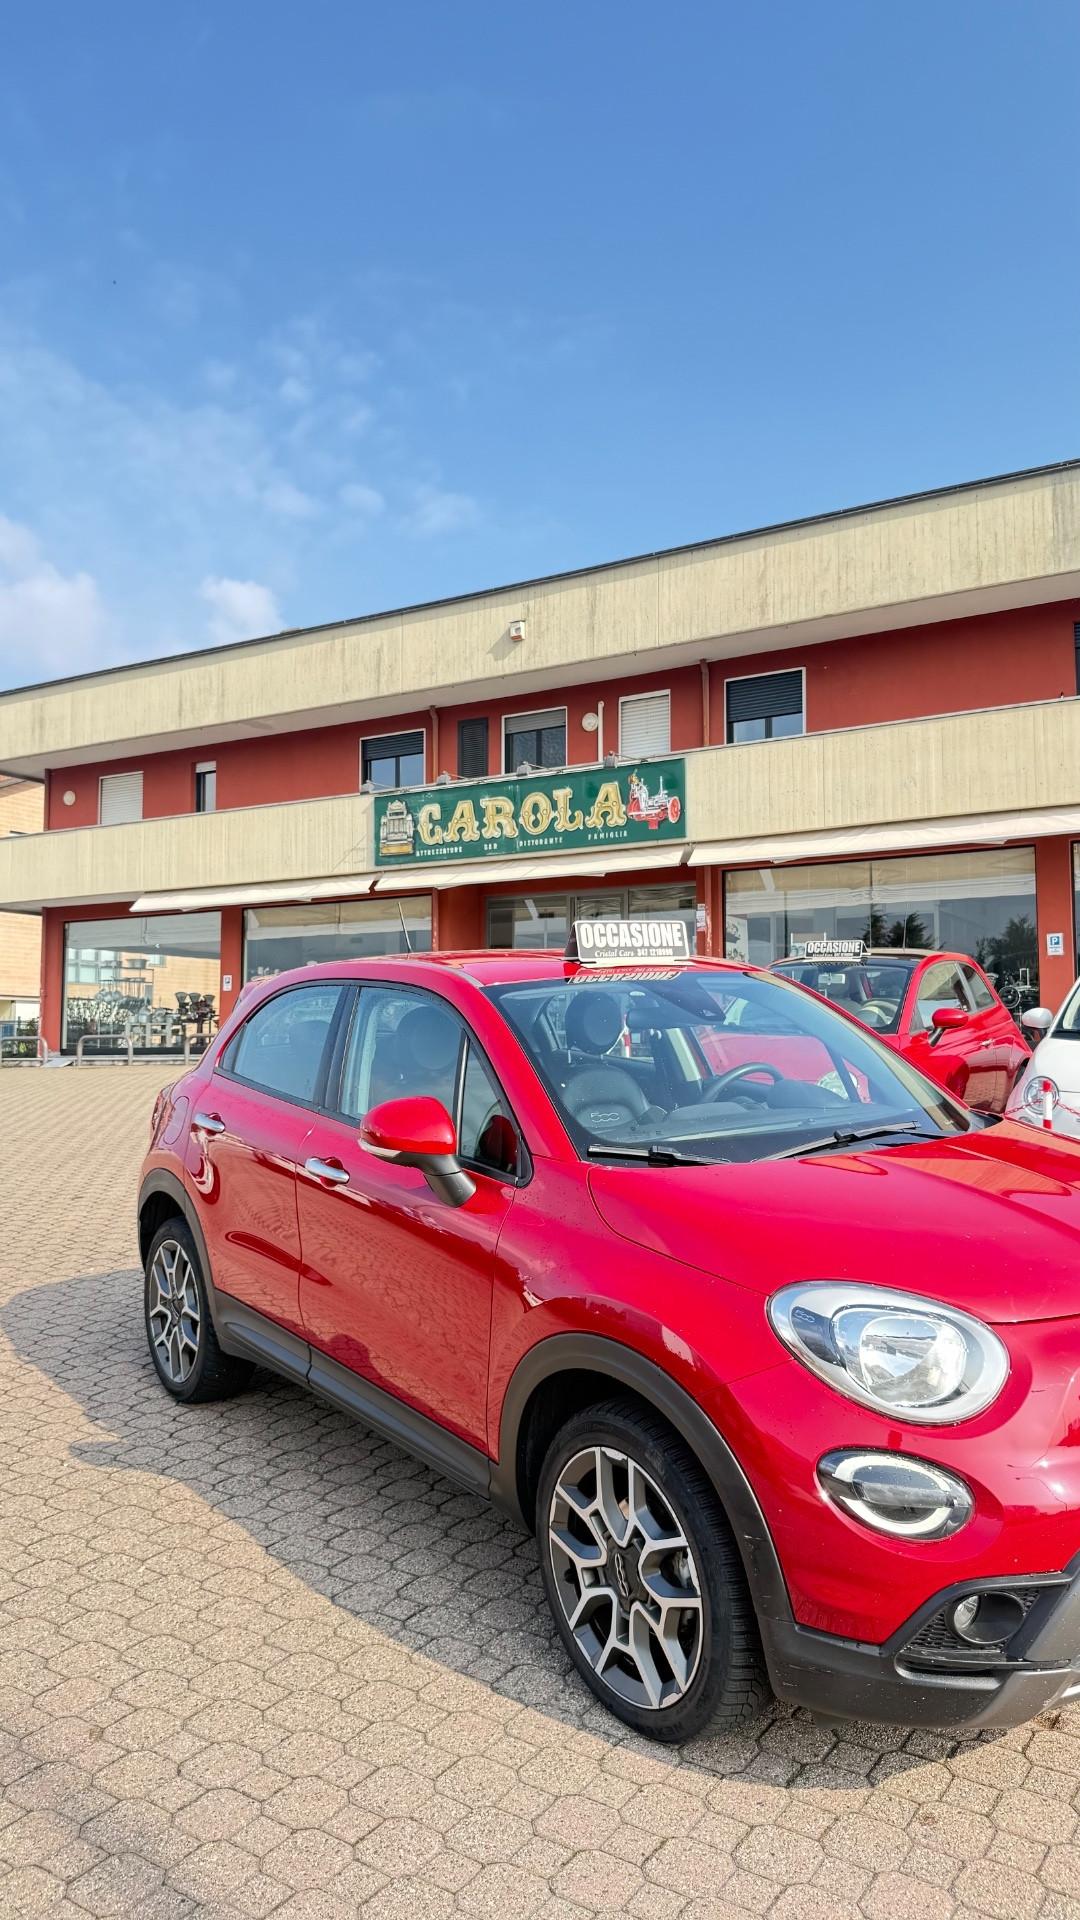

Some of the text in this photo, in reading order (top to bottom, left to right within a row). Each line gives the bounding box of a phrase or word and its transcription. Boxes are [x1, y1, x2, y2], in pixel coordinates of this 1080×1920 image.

[417, 781, 628, 846] CAROLA
[416, 830, 628, 857] ATTREZZATURE BAR RISTORANTE FAMIGLIA
[579, 923, 683, 949] OCCASIONE
[619, 949, 634, 957] Cars
[807, 941, 860, 954] OCCASIONE
[590, 1112, 620, 1123] 500
